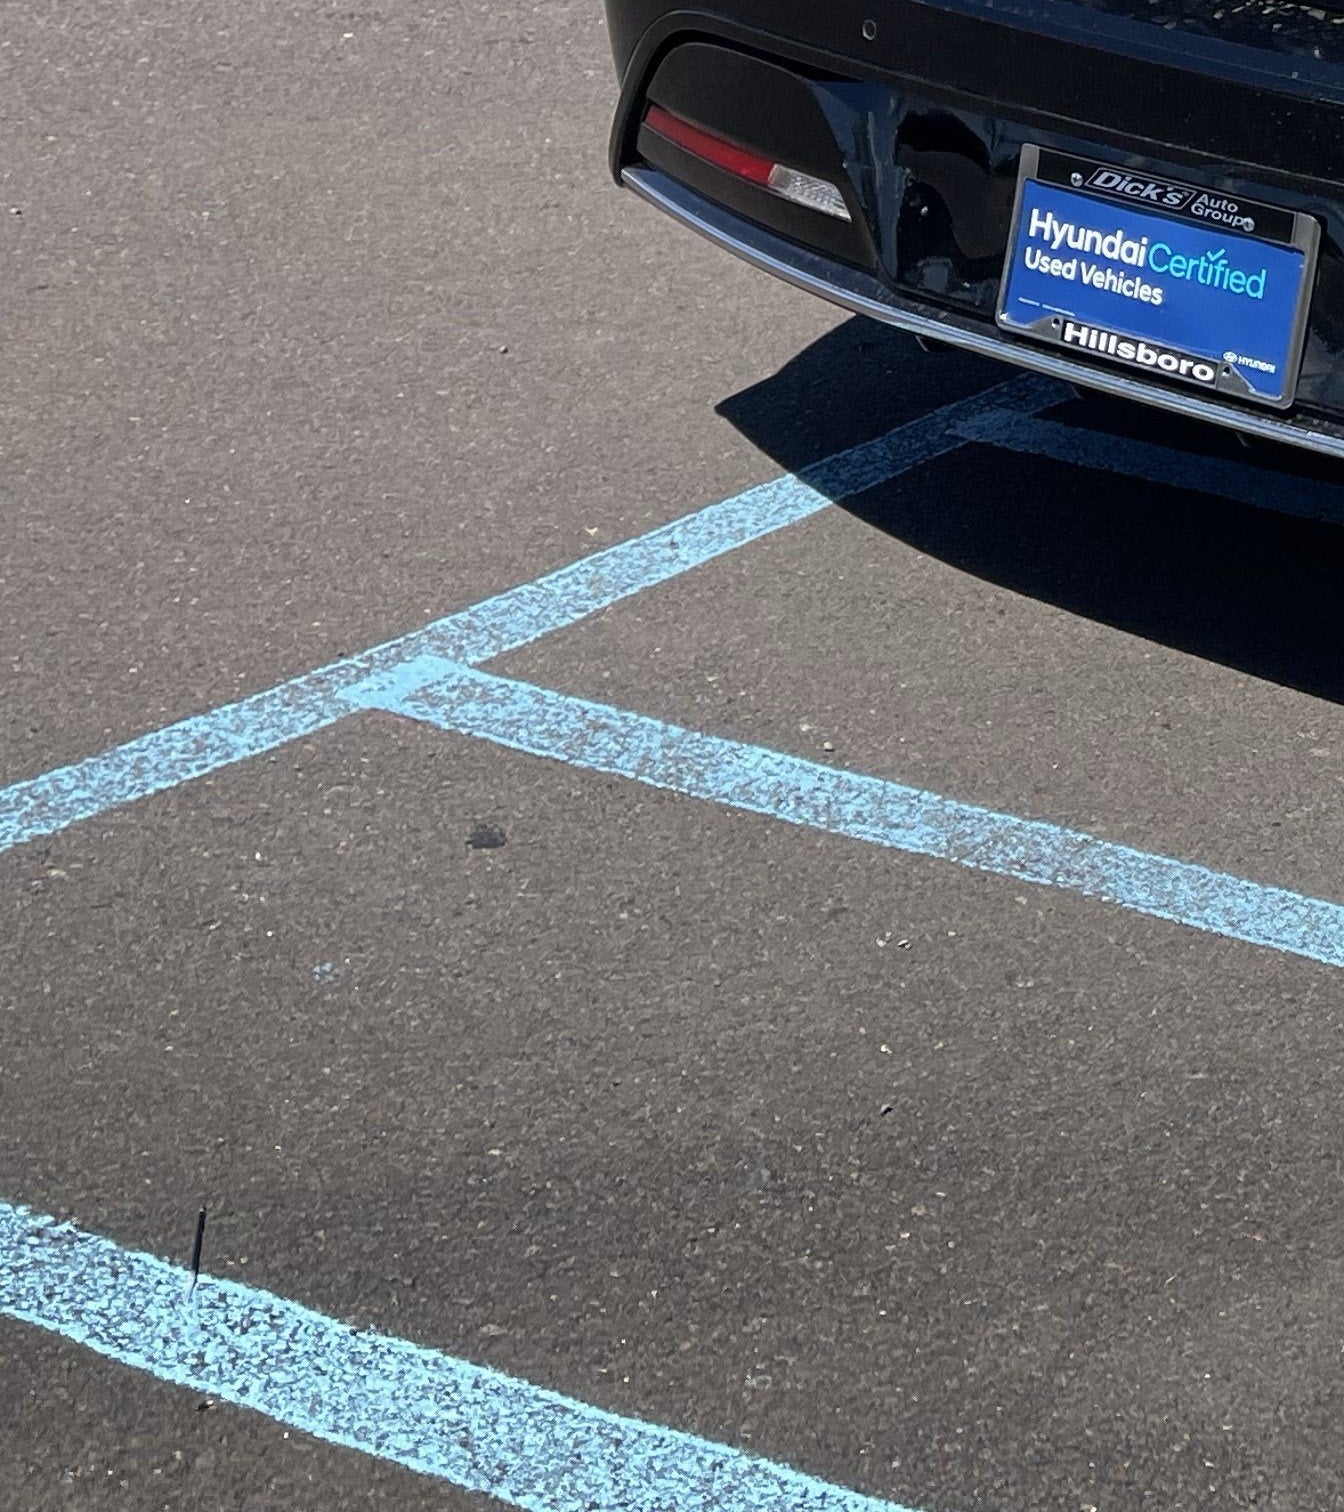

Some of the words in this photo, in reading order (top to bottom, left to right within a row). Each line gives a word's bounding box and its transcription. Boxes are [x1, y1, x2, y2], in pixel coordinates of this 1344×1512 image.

[1093, 171, 1184, 205] Dick's
[1195, 193, 1239, 213] Auto
[1190, 202, 1246, 228] Group
[1025, 246, 1078, 281] Used
[1080, 261, 1164, 306] Vehicles
[1028, 208, 1149, 268] Hyundai
[1148, 242, 1267, 299] Certified
[1063, 322, 1215, 382] Hillsboro
